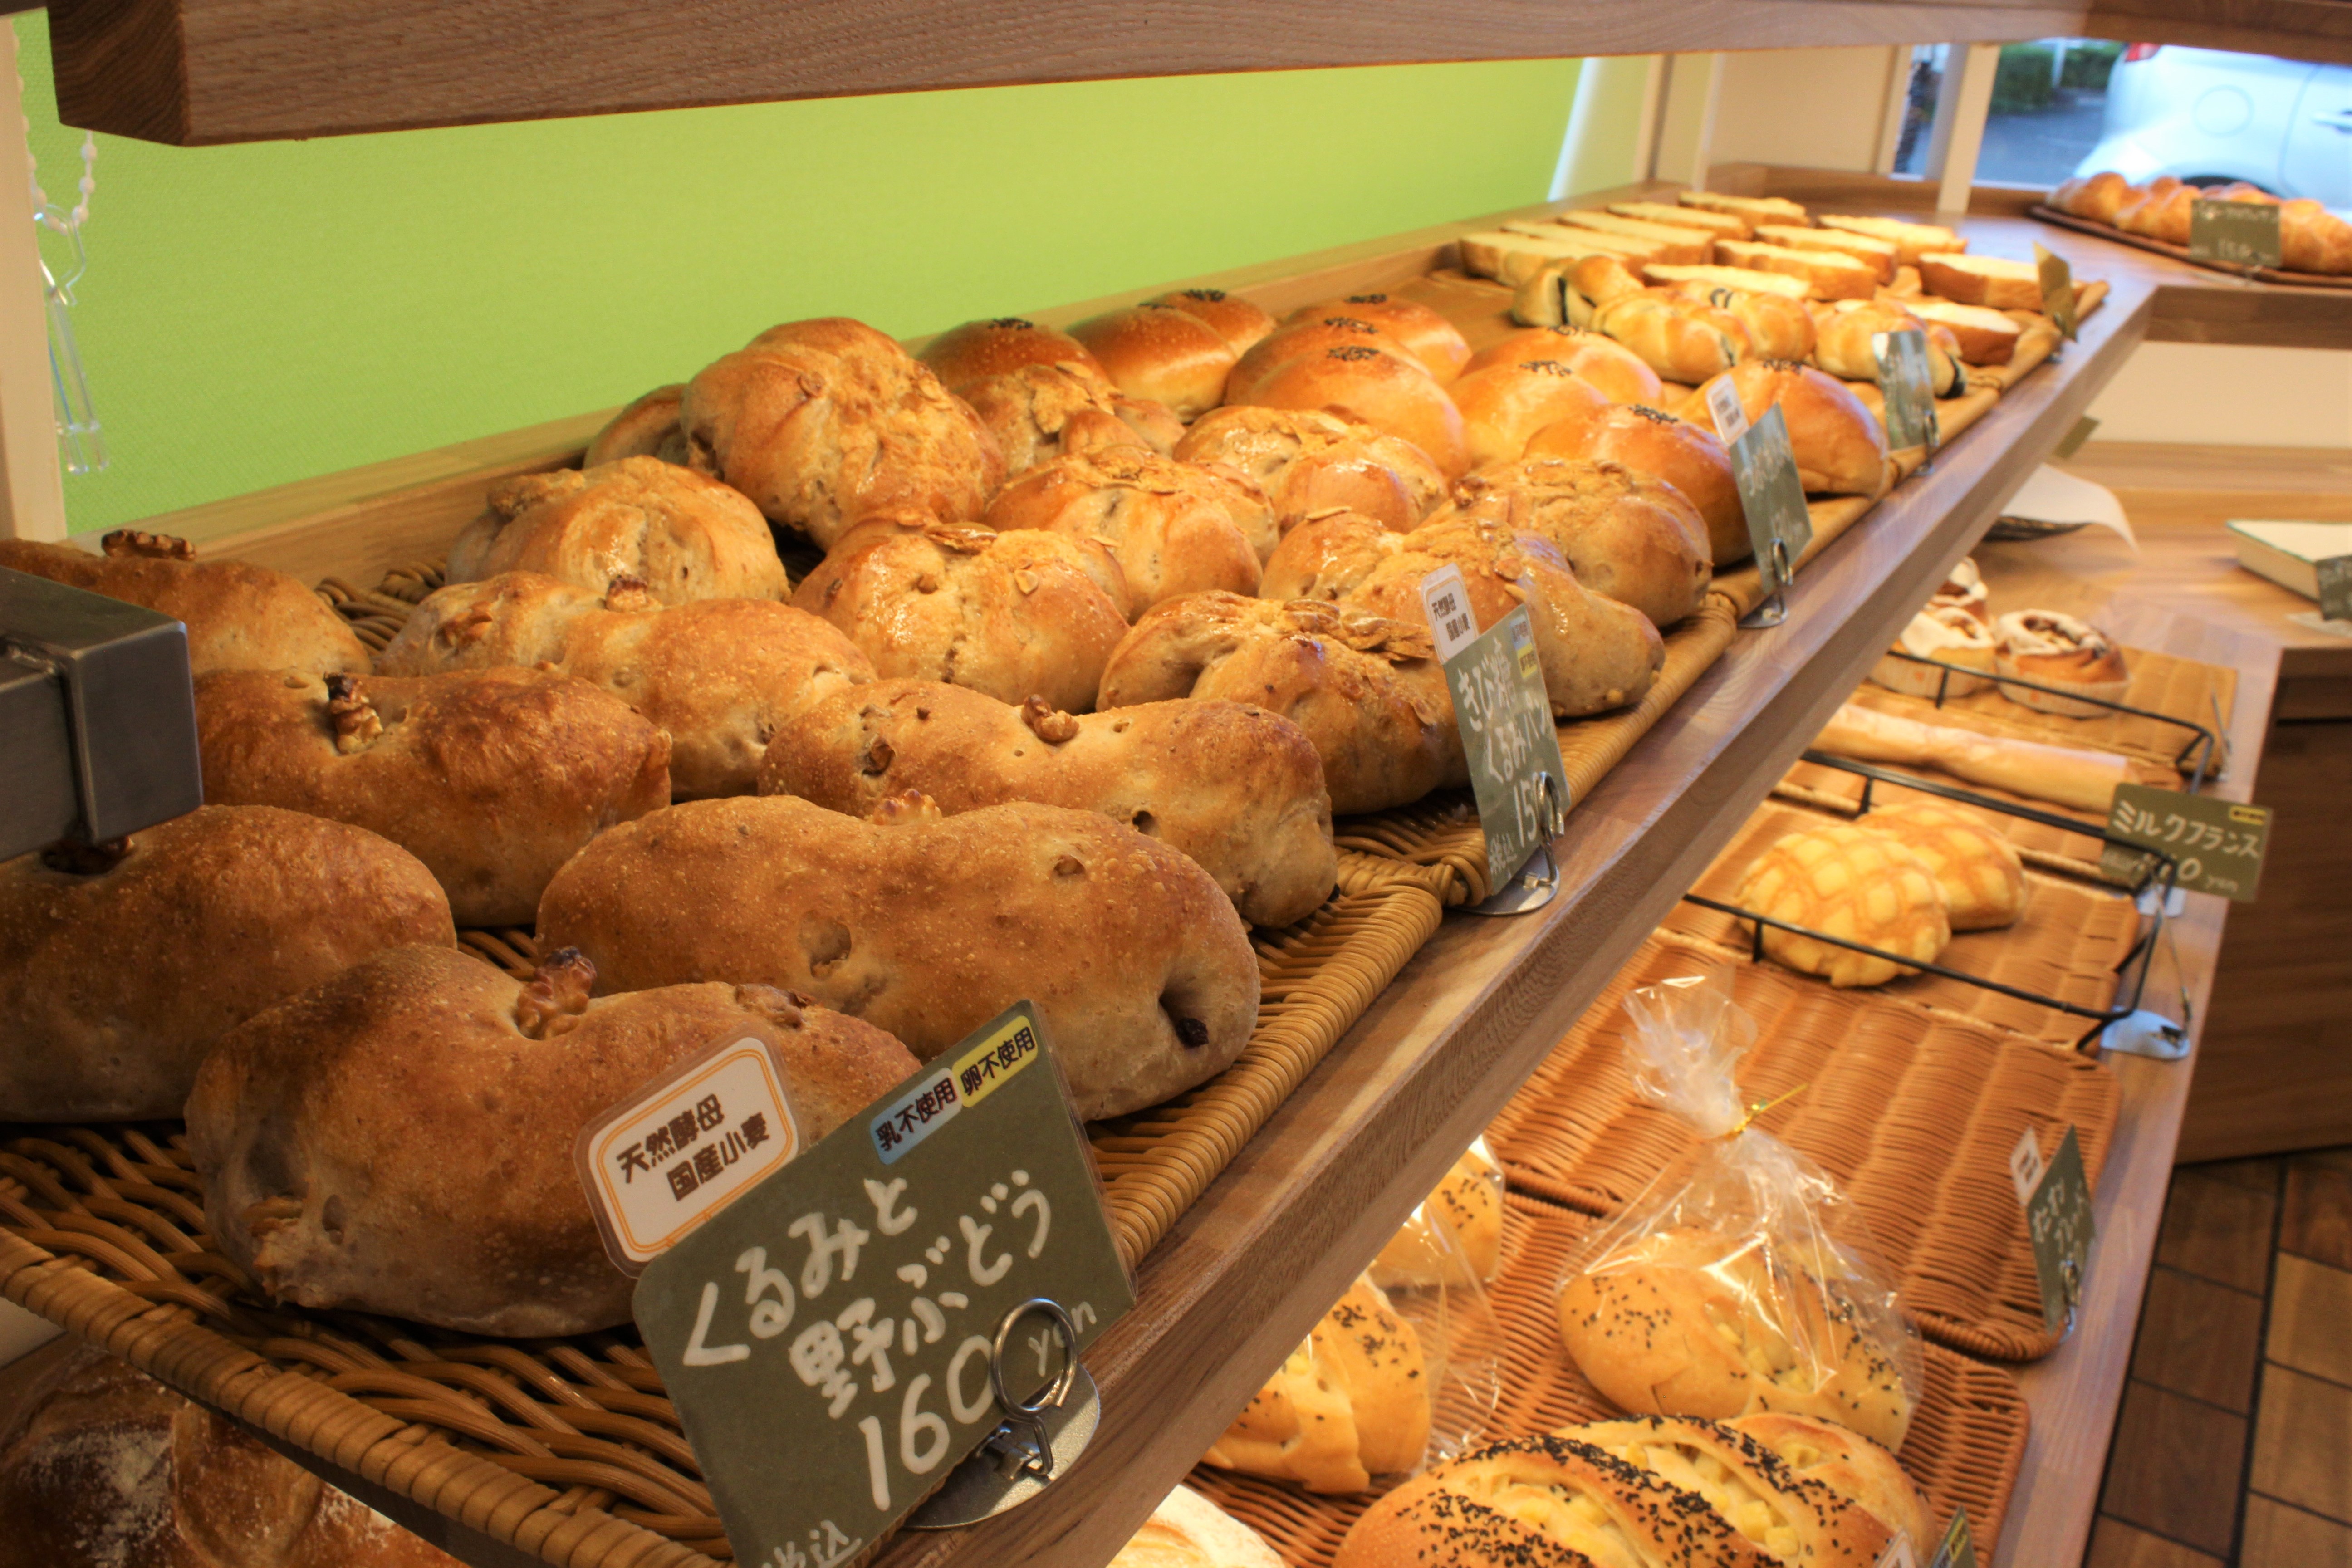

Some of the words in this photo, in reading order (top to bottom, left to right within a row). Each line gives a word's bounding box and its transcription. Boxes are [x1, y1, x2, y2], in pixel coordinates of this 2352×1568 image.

[2112, 800, 2260, 859] ミルクフランス
[960, 1026, 1035, 1096] 卵不使用
[616, 1093, 725, 1184] 天然酵母
[666, 1112, 769, 1201] 国産小麦
[876, 1077, 958, 1151] 乳不使用
[682, 1178, 917, 1367] くるみと
[789, 1169, 1051, 1419] 野ぶどう
[858, 1335, 995, 1511] 160
